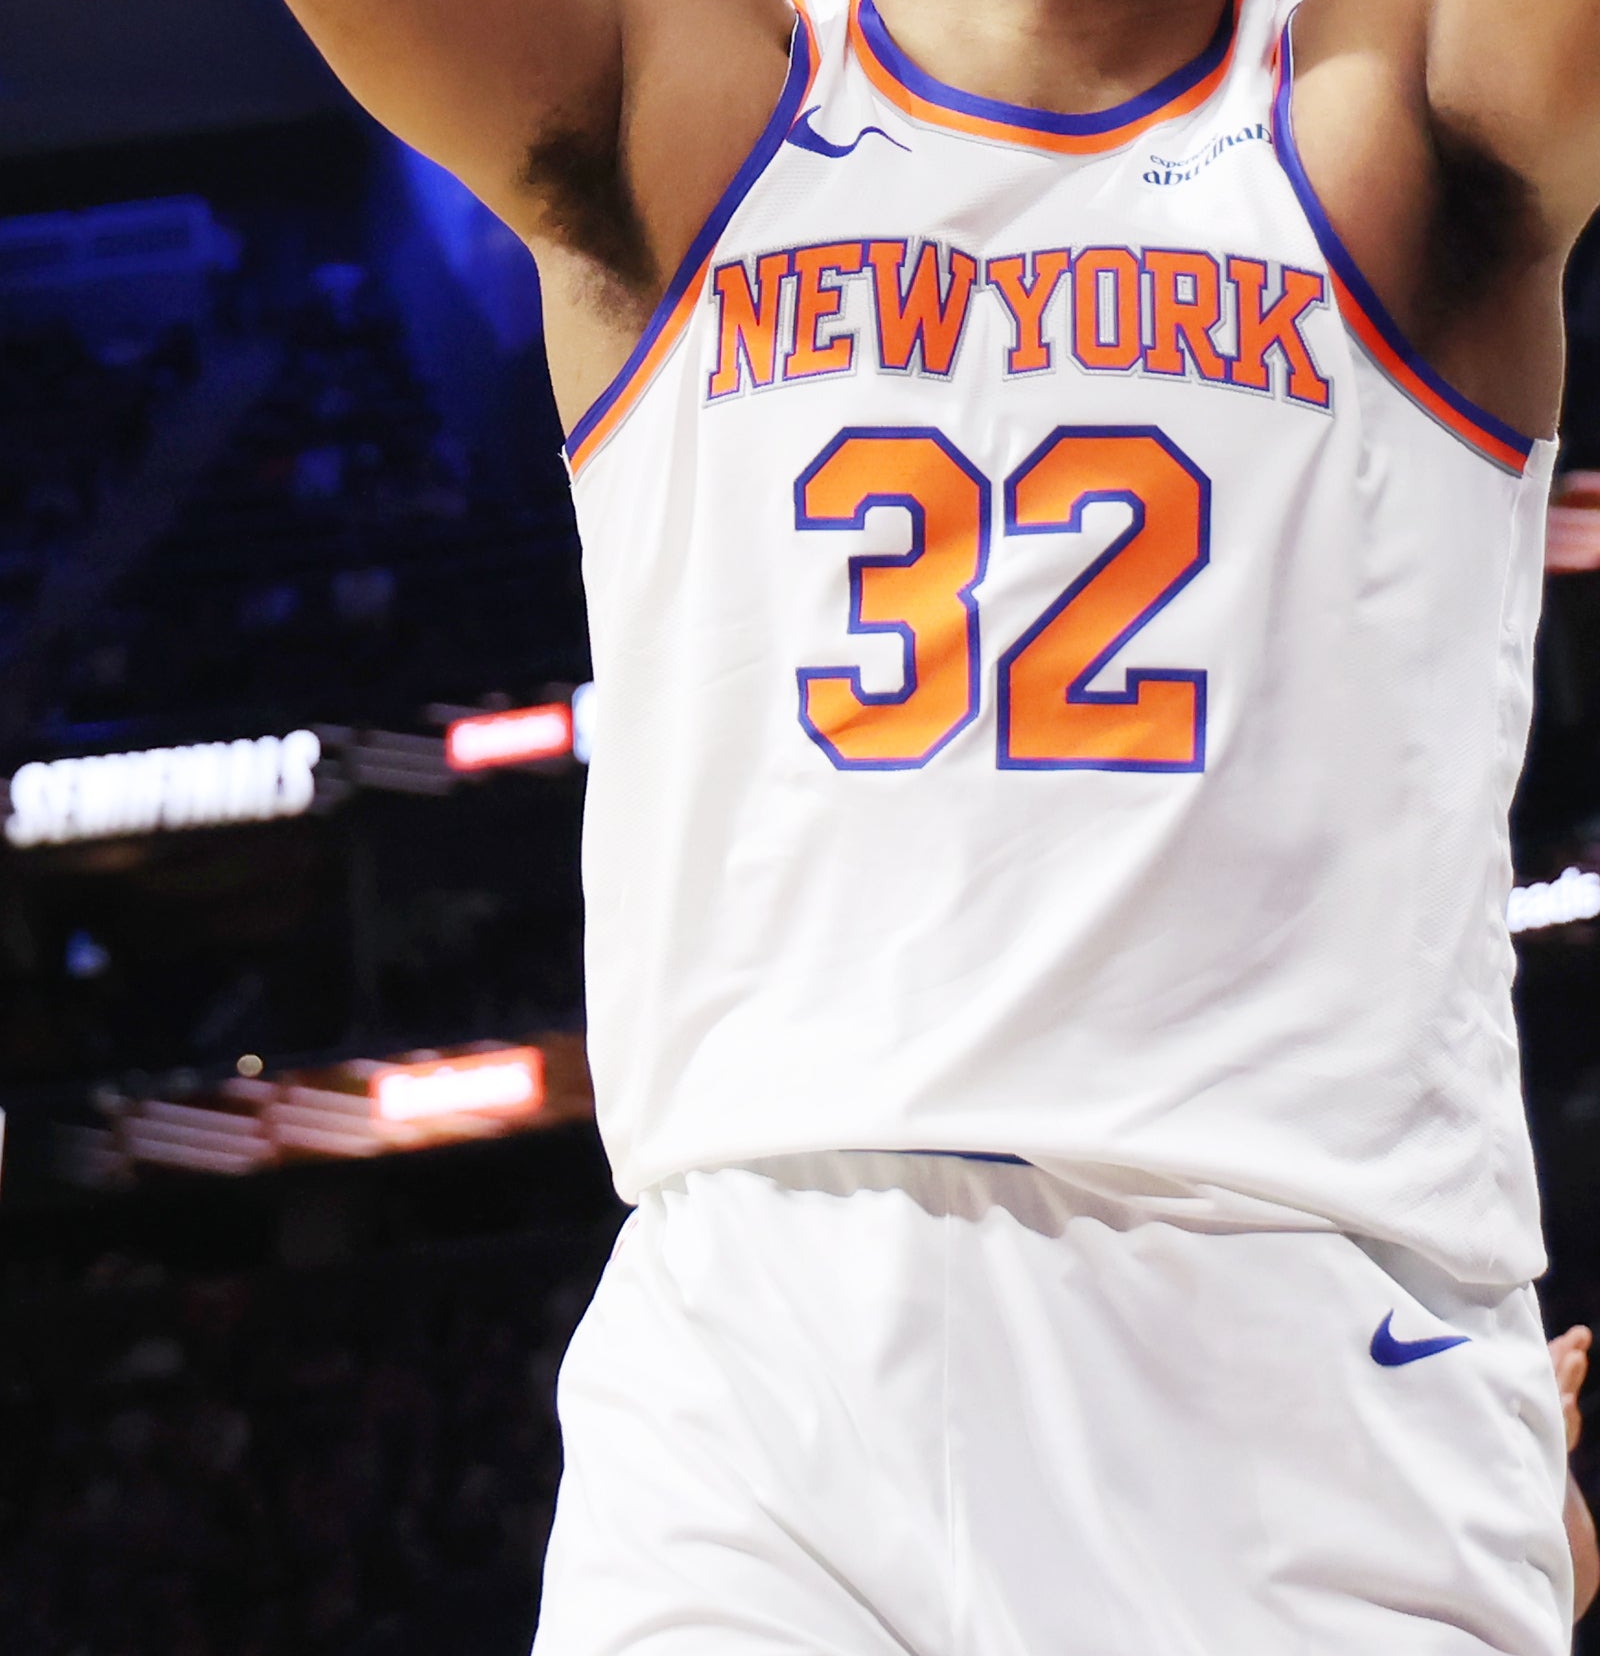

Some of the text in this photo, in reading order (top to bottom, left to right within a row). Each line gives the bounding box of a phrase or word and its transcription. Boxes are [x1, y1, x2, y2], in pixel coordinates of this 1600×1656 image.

[703, 234, 1332, 415] NEW YORK
[793, 424, 1211, 773] 32
